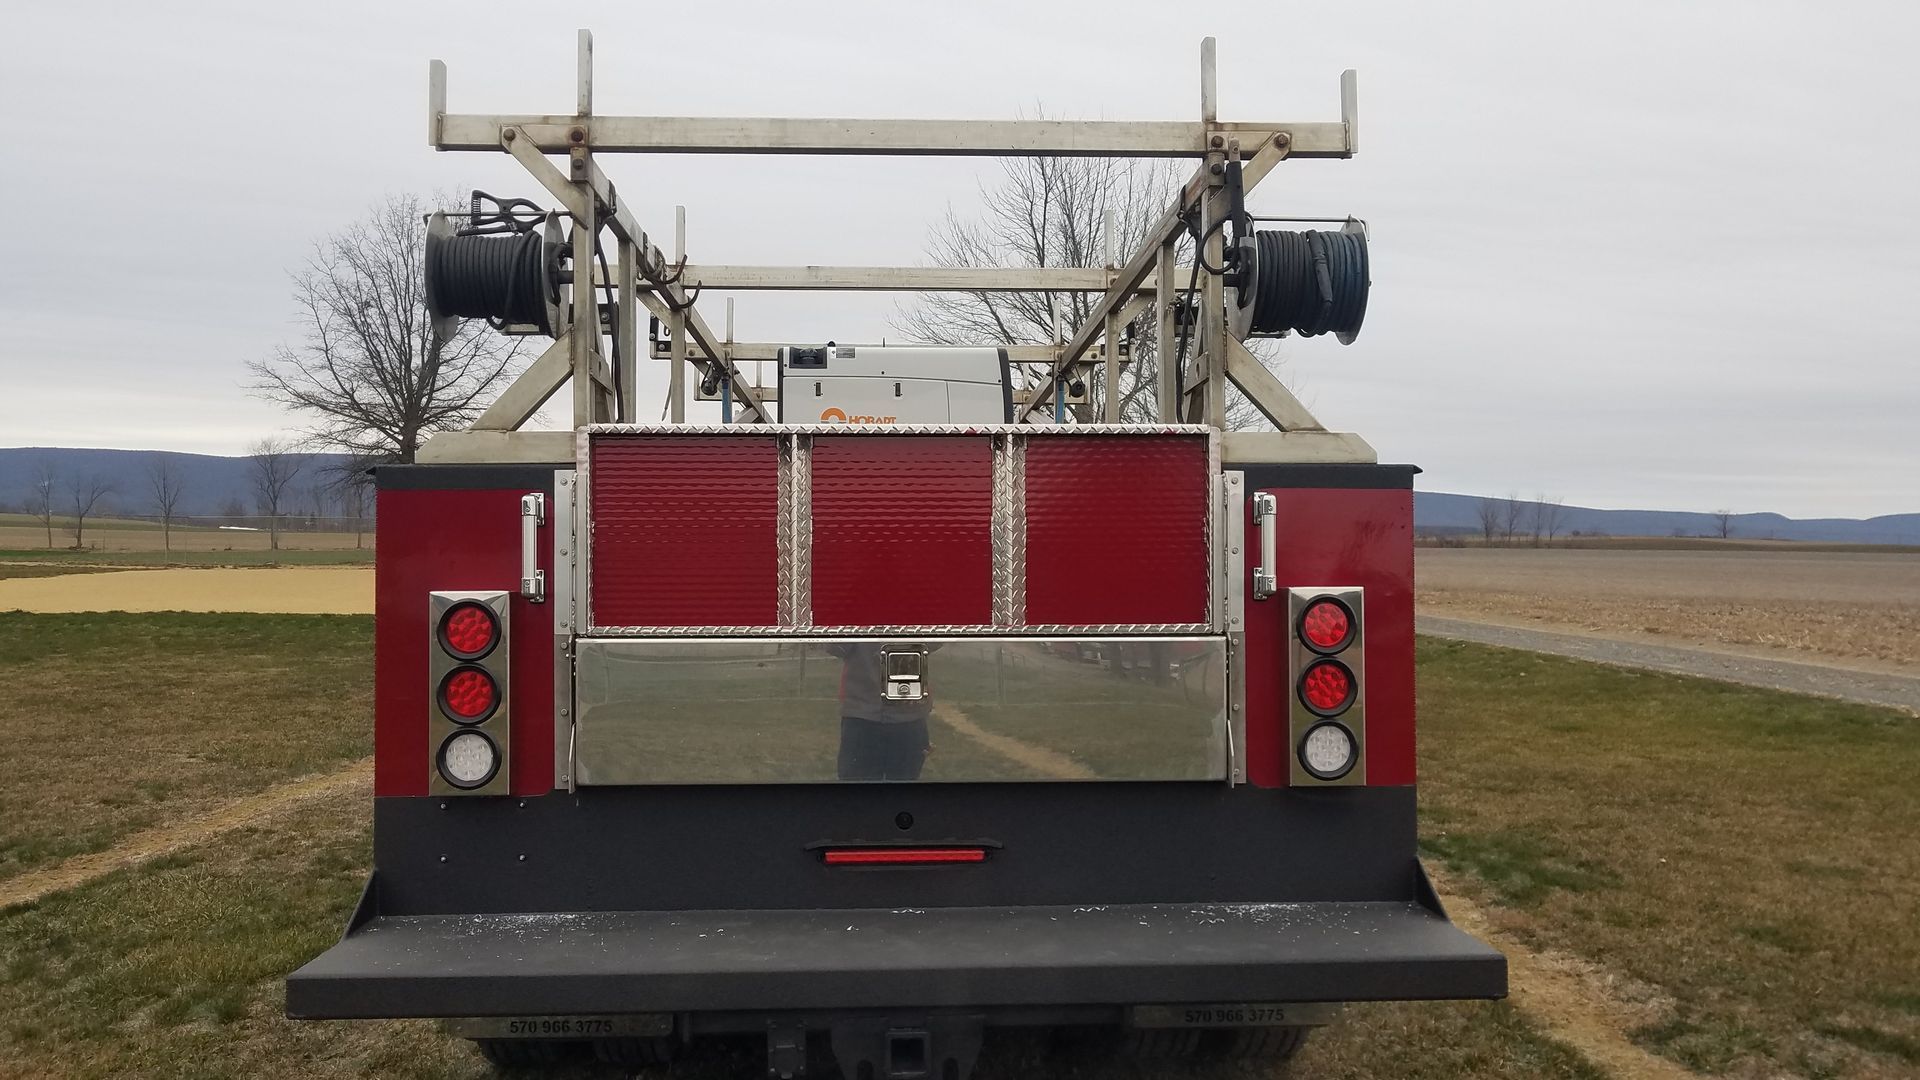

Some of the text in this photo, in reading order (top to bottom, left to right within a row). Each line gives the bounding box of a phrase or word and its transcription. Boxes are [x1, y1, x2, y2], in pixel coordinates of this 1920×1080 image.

[1185, 1009, 1284, 1023] 570 966 3775
[510, 1020, 612, 1033] 570 966 3775
